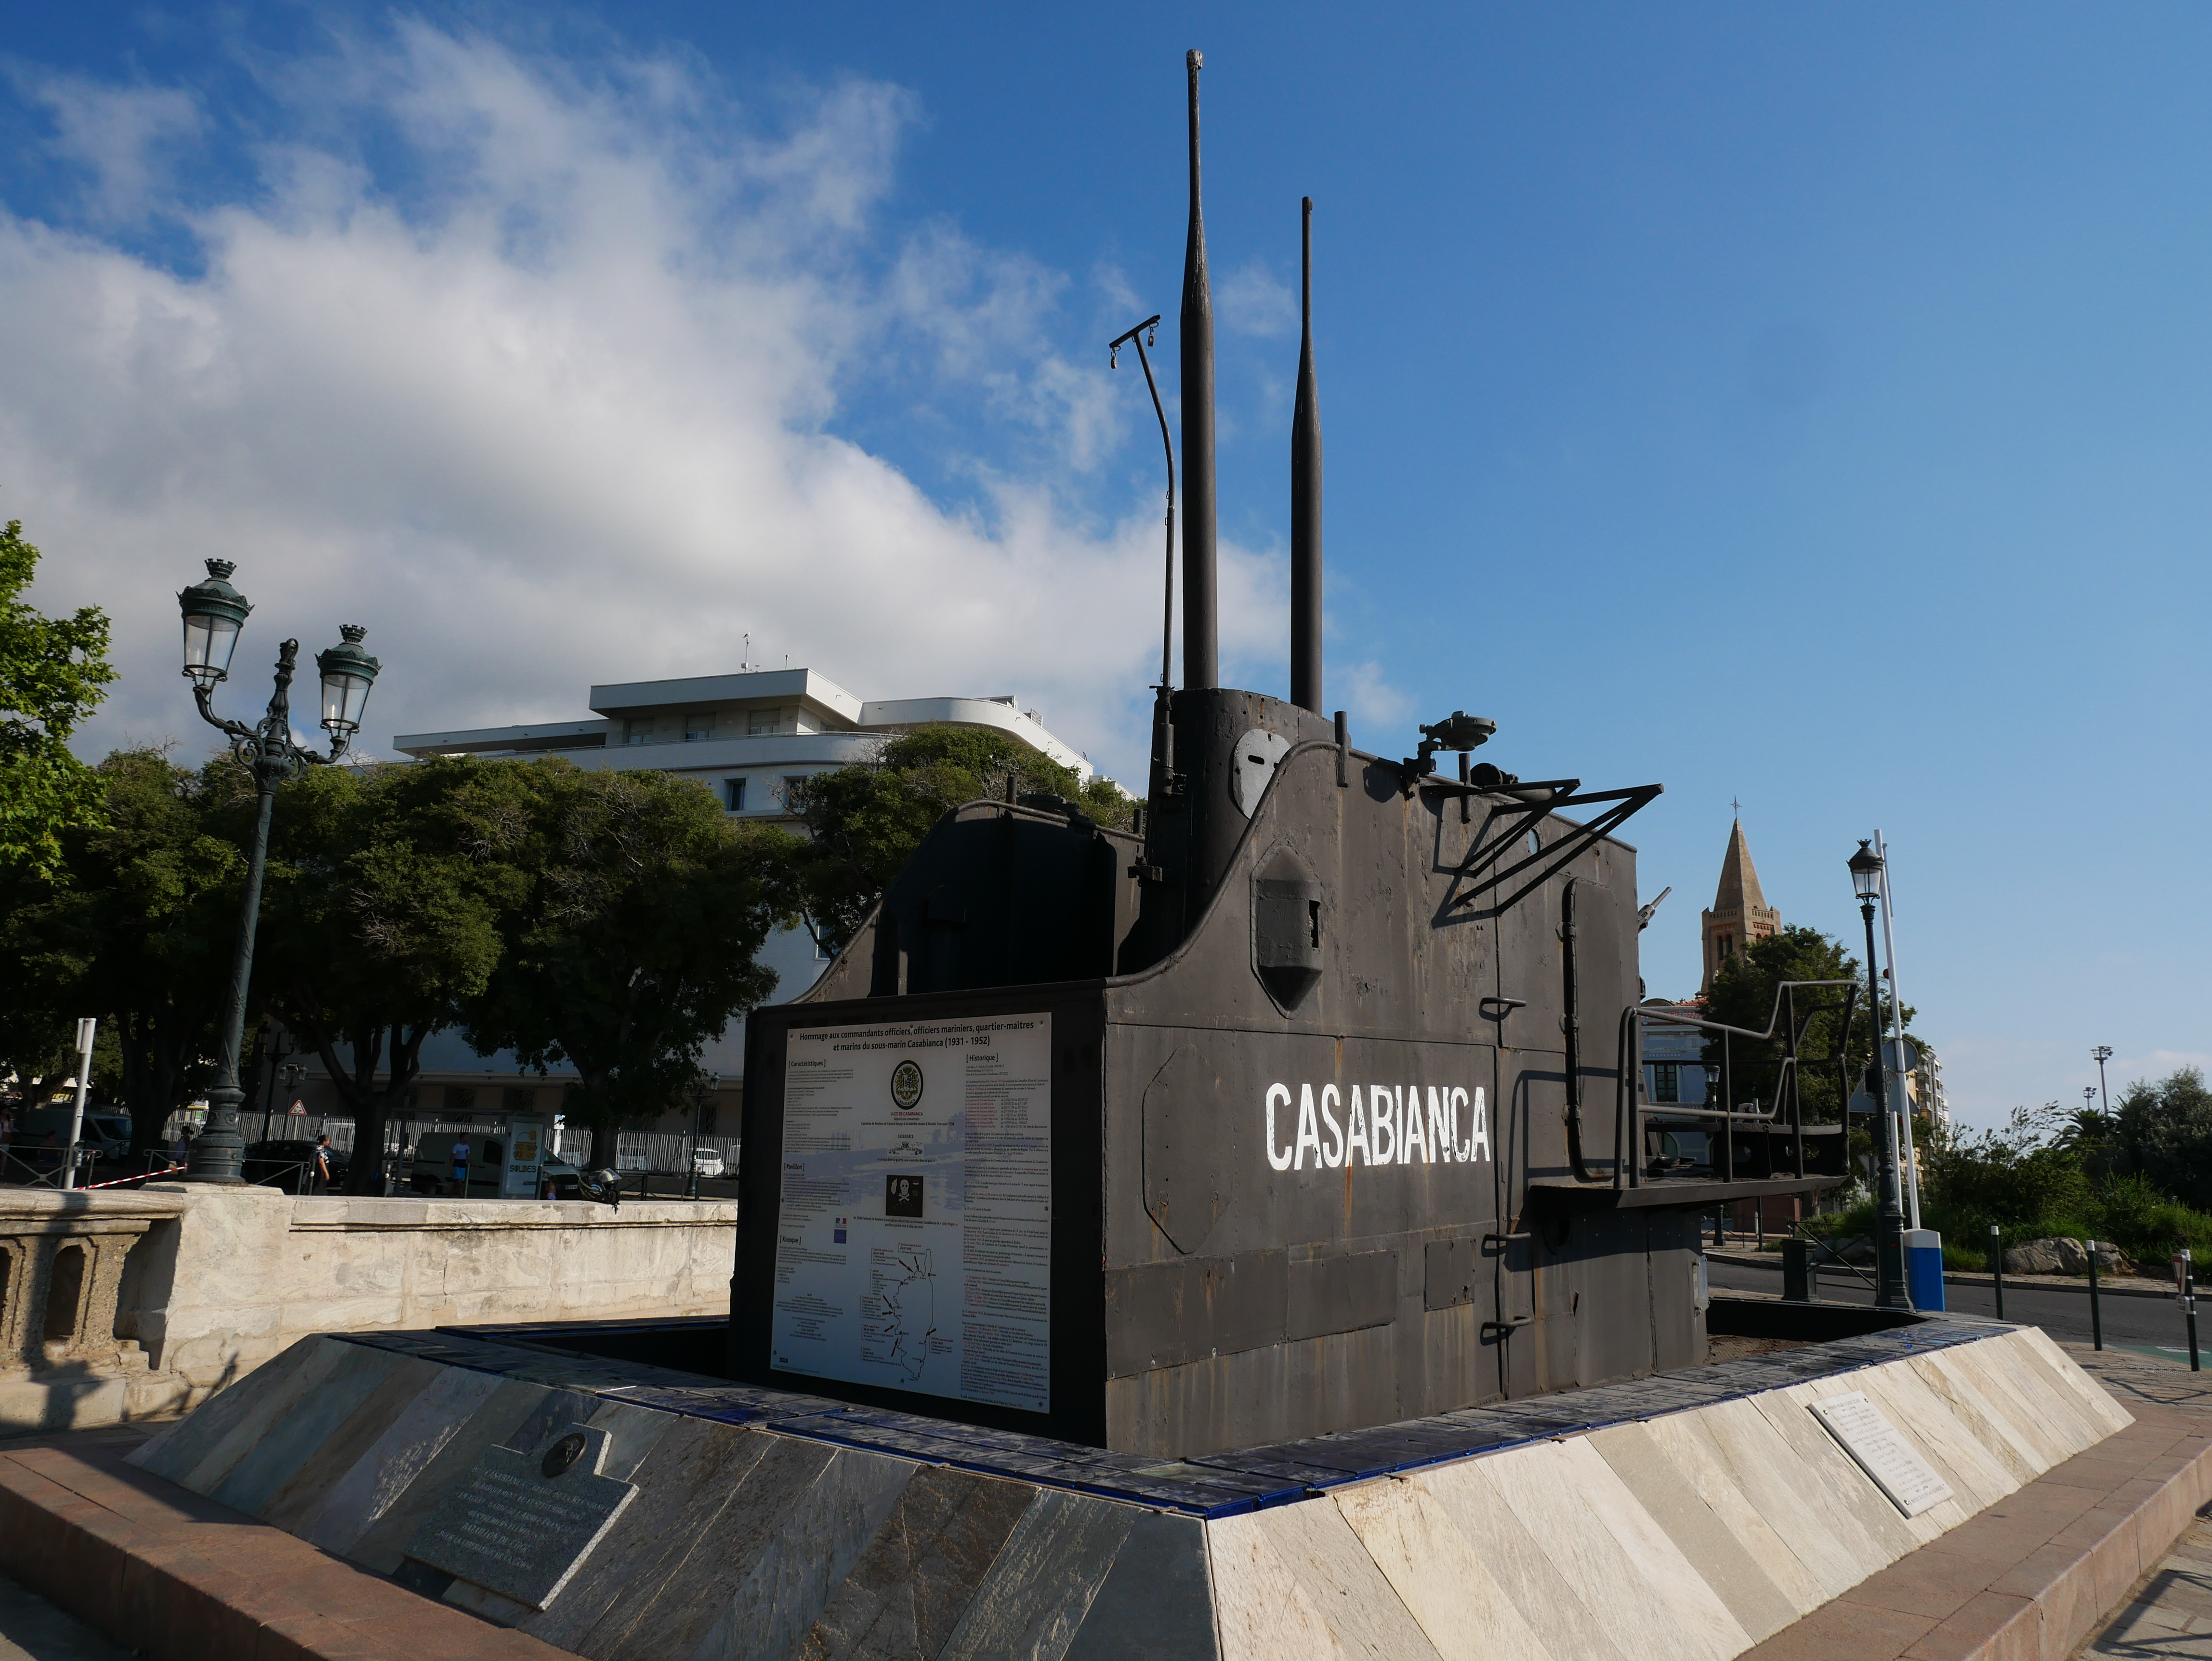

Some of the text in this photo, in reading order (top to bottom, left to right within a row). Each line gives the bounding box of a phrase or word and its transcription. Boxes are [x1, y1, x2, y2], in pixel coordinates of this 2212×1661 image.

[800, 1032, 828, 1042] Hommage
[841, 1029, 883, 1038] commandants
[885, 1026, 913, 1036] officiers,
[913, 1025, 940, 1035] officiers
[941, 1023, 974, 1033] mariniers,
[975, 1020, 1034, 1031] quartier-maîtres
[841, 1042, 861, 1051] marins
[871, 1041, 906, 1049] sous-marin
[908, 1038, 943, 1048] Casabianca
[945, 1037, 963, 1048] (1931
[971, 1036, 990, 1047] 1952)
[969, 1054, 995, 1062] Historique
[1266, 1082, 1490, 1171] CASABIANCA
[782, 1236, 799, 1244] Kiosque
